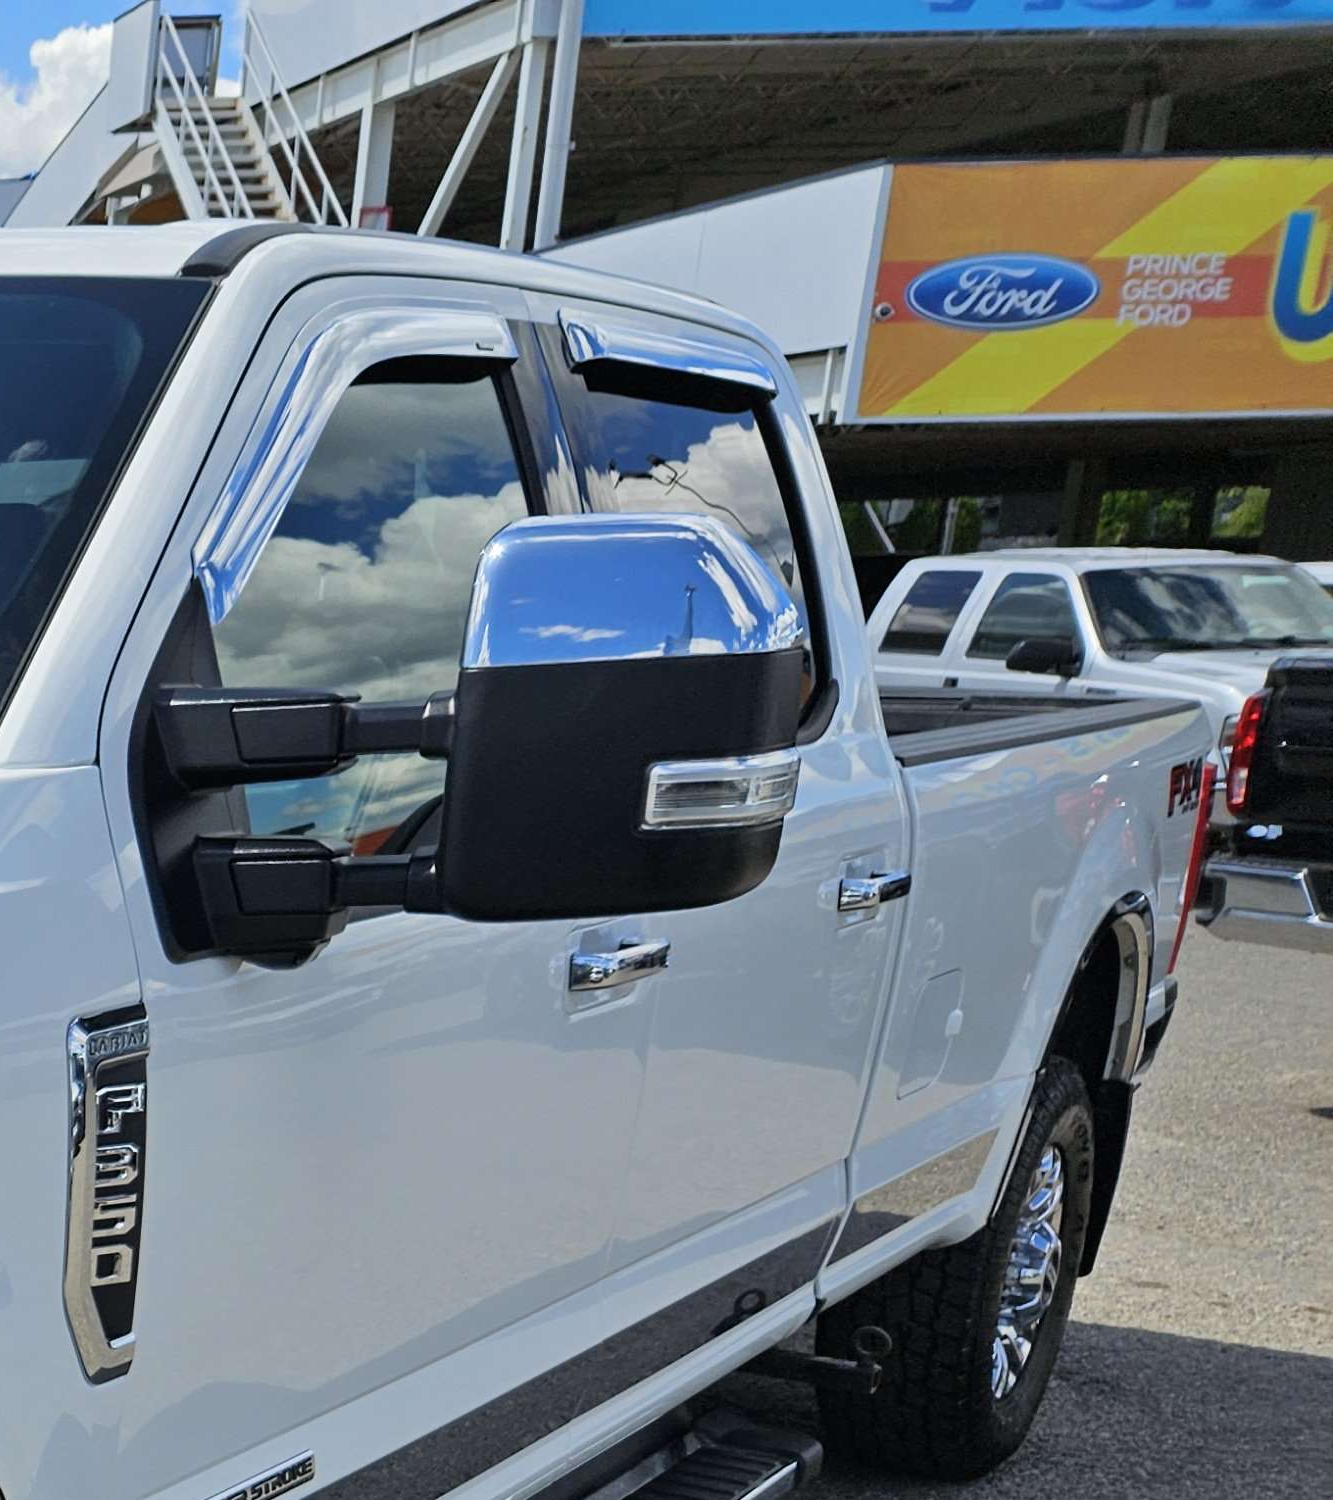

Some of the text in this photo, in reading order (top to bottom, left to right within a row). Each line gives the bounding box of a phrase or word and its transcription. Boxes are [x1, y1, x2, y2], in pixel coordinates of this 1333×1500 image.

[1126, 252, 1227, 277] PRINCE
[944, 264, 1064, 317] Ford
[1121, 277, 1234, 302] GEORGE
[1114, 303, 1192, 328] FORD
